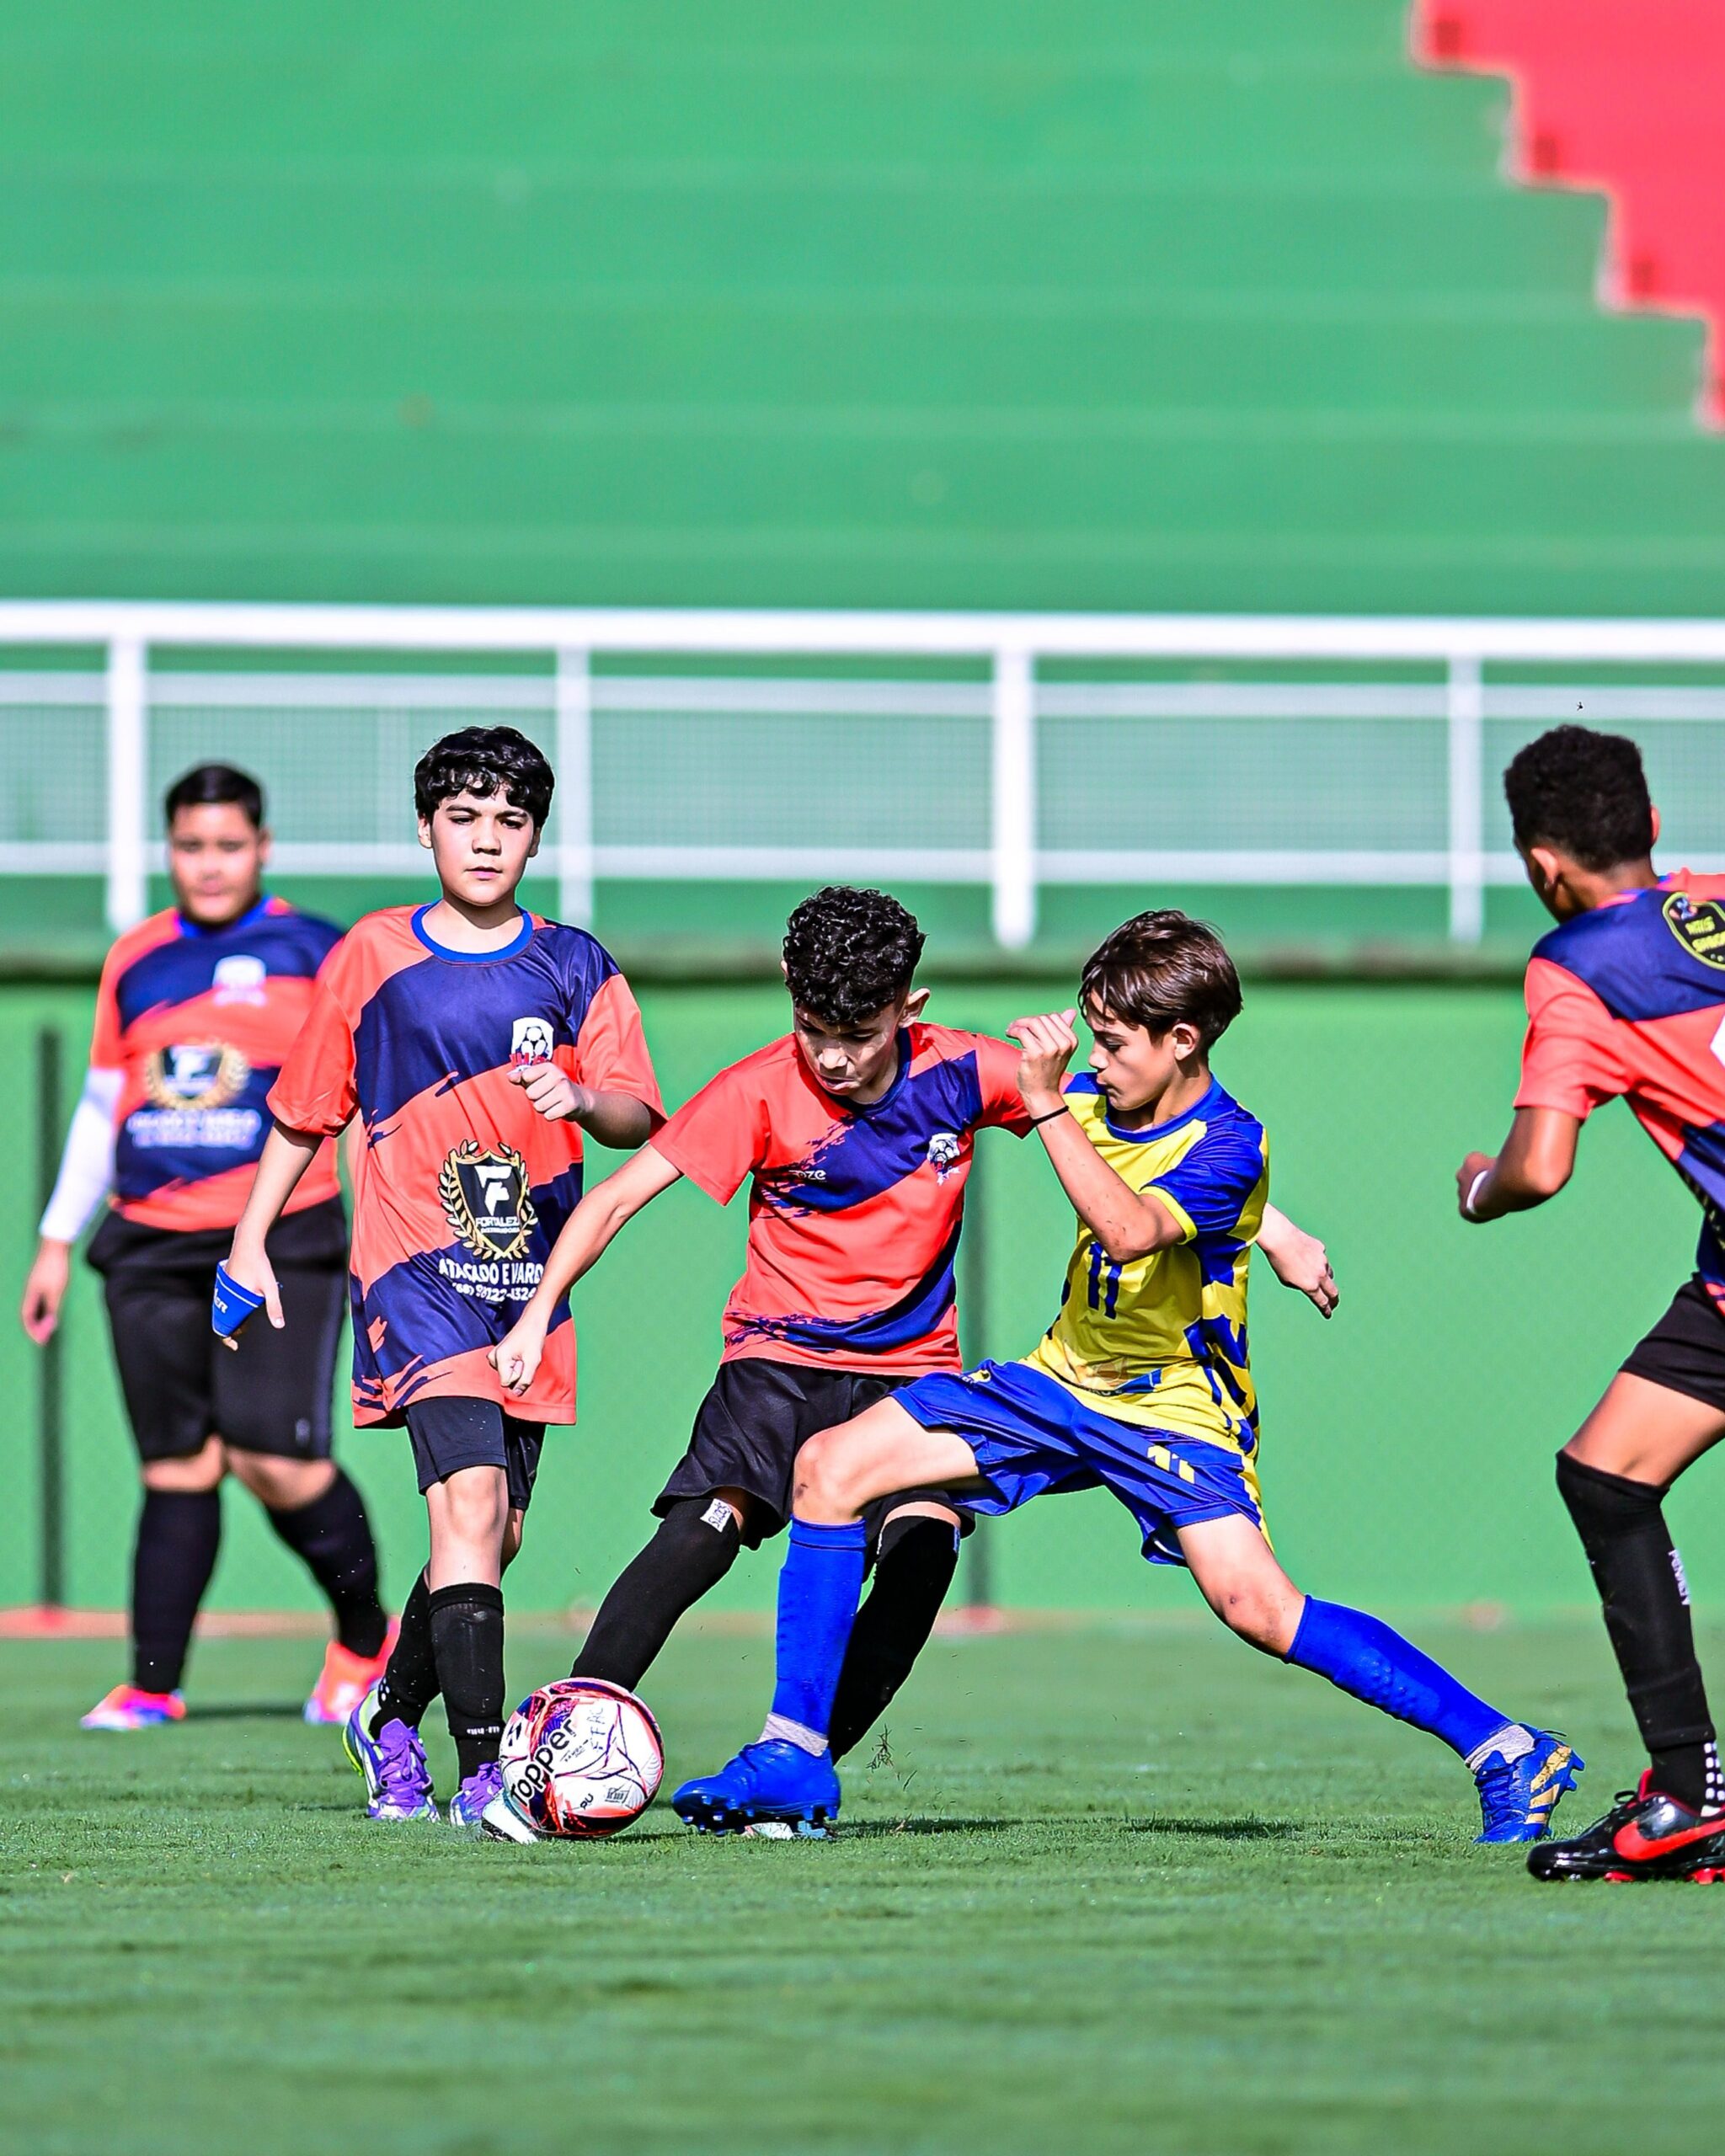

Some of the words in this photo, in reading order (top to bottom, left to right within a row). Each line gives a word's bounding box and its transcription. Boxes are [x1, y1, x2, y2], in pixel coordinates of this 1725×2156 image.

[439, 1258, 499, 1285] ATACADO
[502, 1263, 510, 1285] E
[1087, 1241, 1123, 1320] 11
[510, 1719, 576, 1806] Topper
